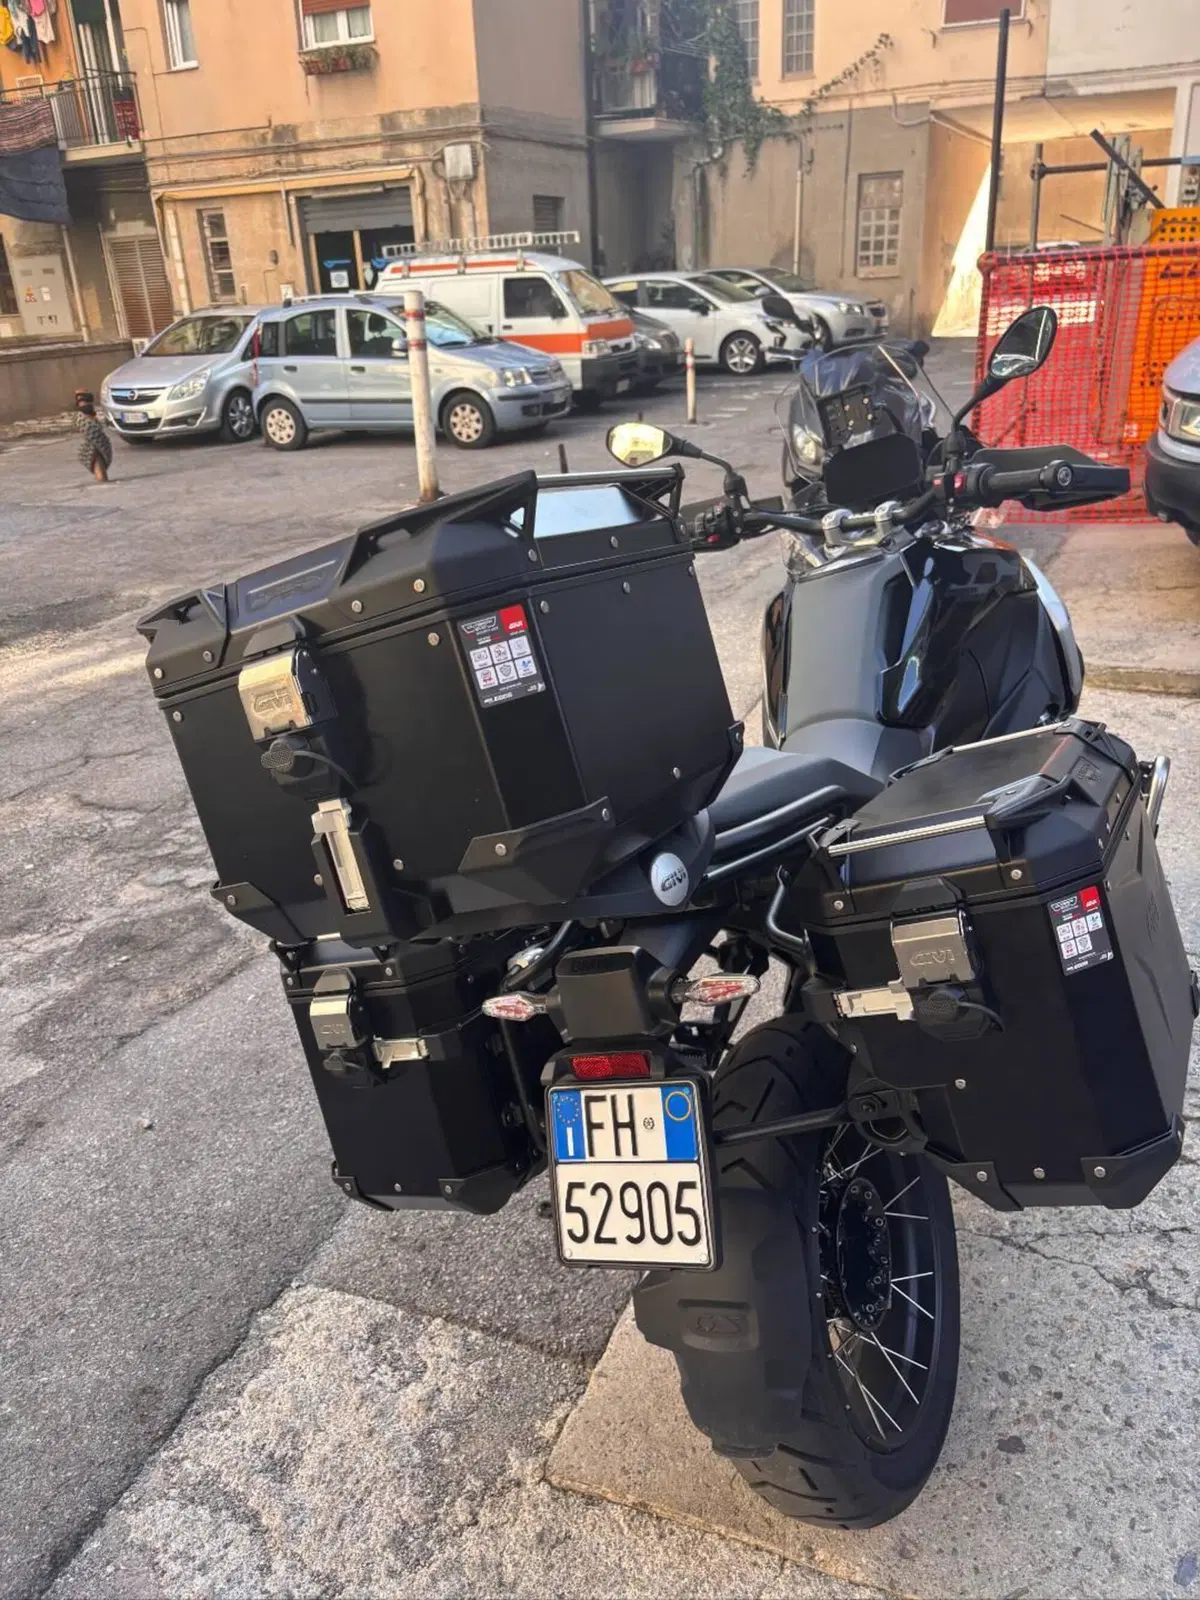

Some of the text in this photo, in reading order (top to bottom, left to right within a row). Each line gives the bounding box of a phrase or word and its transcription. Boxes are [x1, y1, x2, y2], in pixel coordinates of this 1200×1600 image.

[251, 687, 294, 716] GIVI
[660, 868, 687, 892] GIVI
[909, 948, 956, 967] GIVI
[584, 1094, 639, 1157] FH
[565, 1181, 702, 1247] 52905
